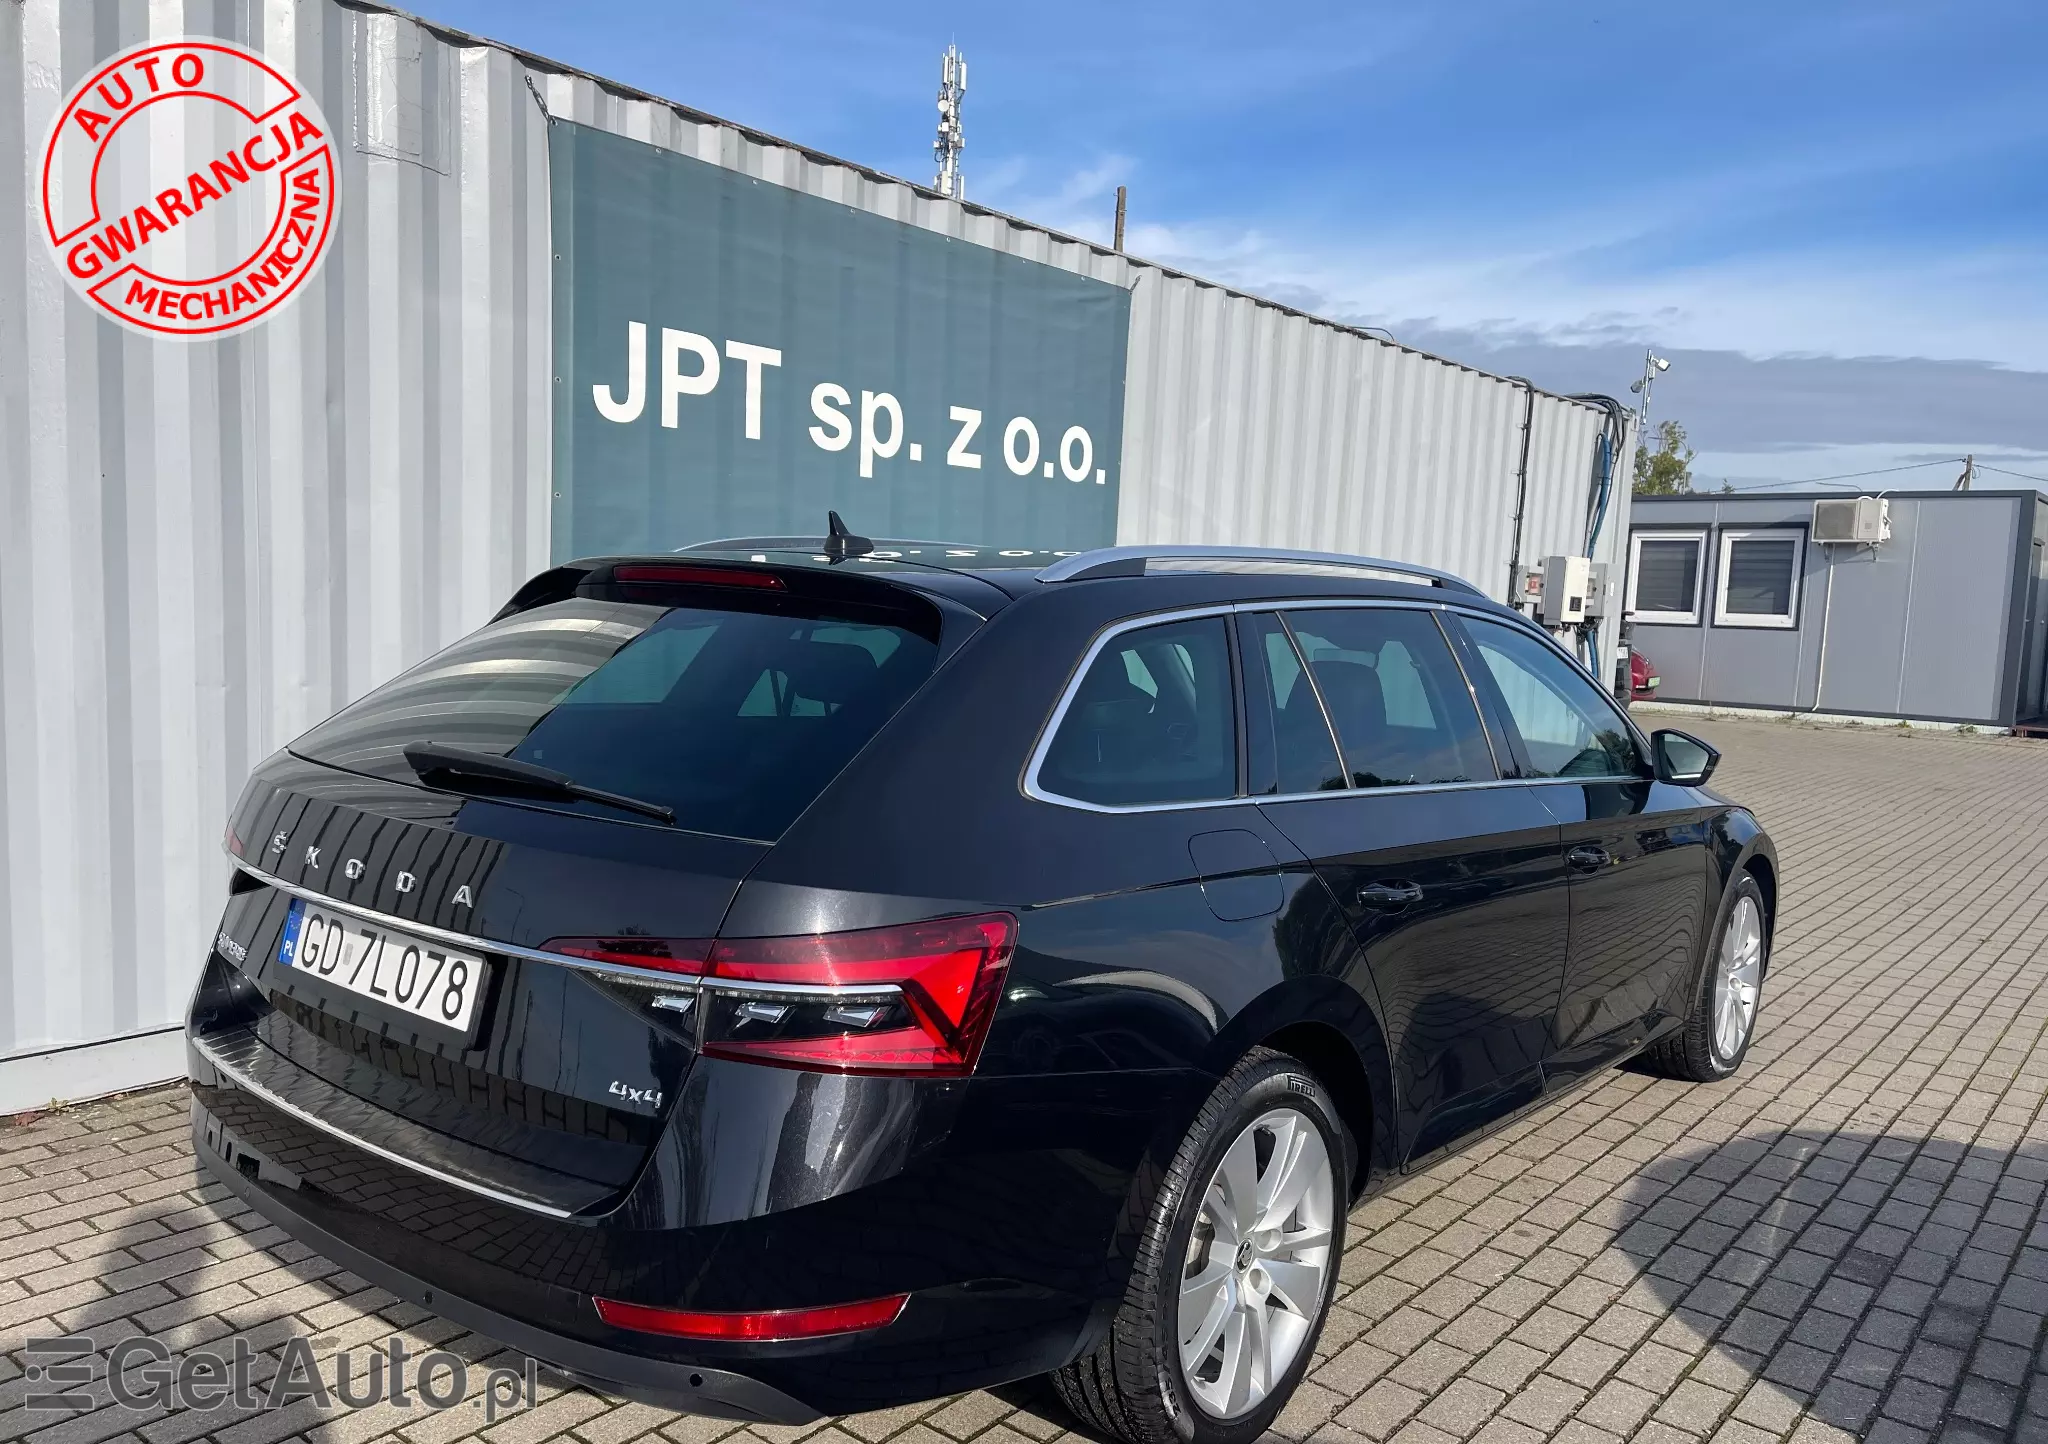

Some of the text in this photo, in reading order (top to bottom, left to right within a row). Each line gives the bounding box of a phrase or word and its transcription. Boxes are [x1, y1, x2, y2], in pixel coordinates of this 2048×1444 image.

[592, 320, 1106, 485] JPT sp. z o.o.
[283, 939, 294, 957] PL
[1287, 1074, 1316, 1098] PIRELLI
